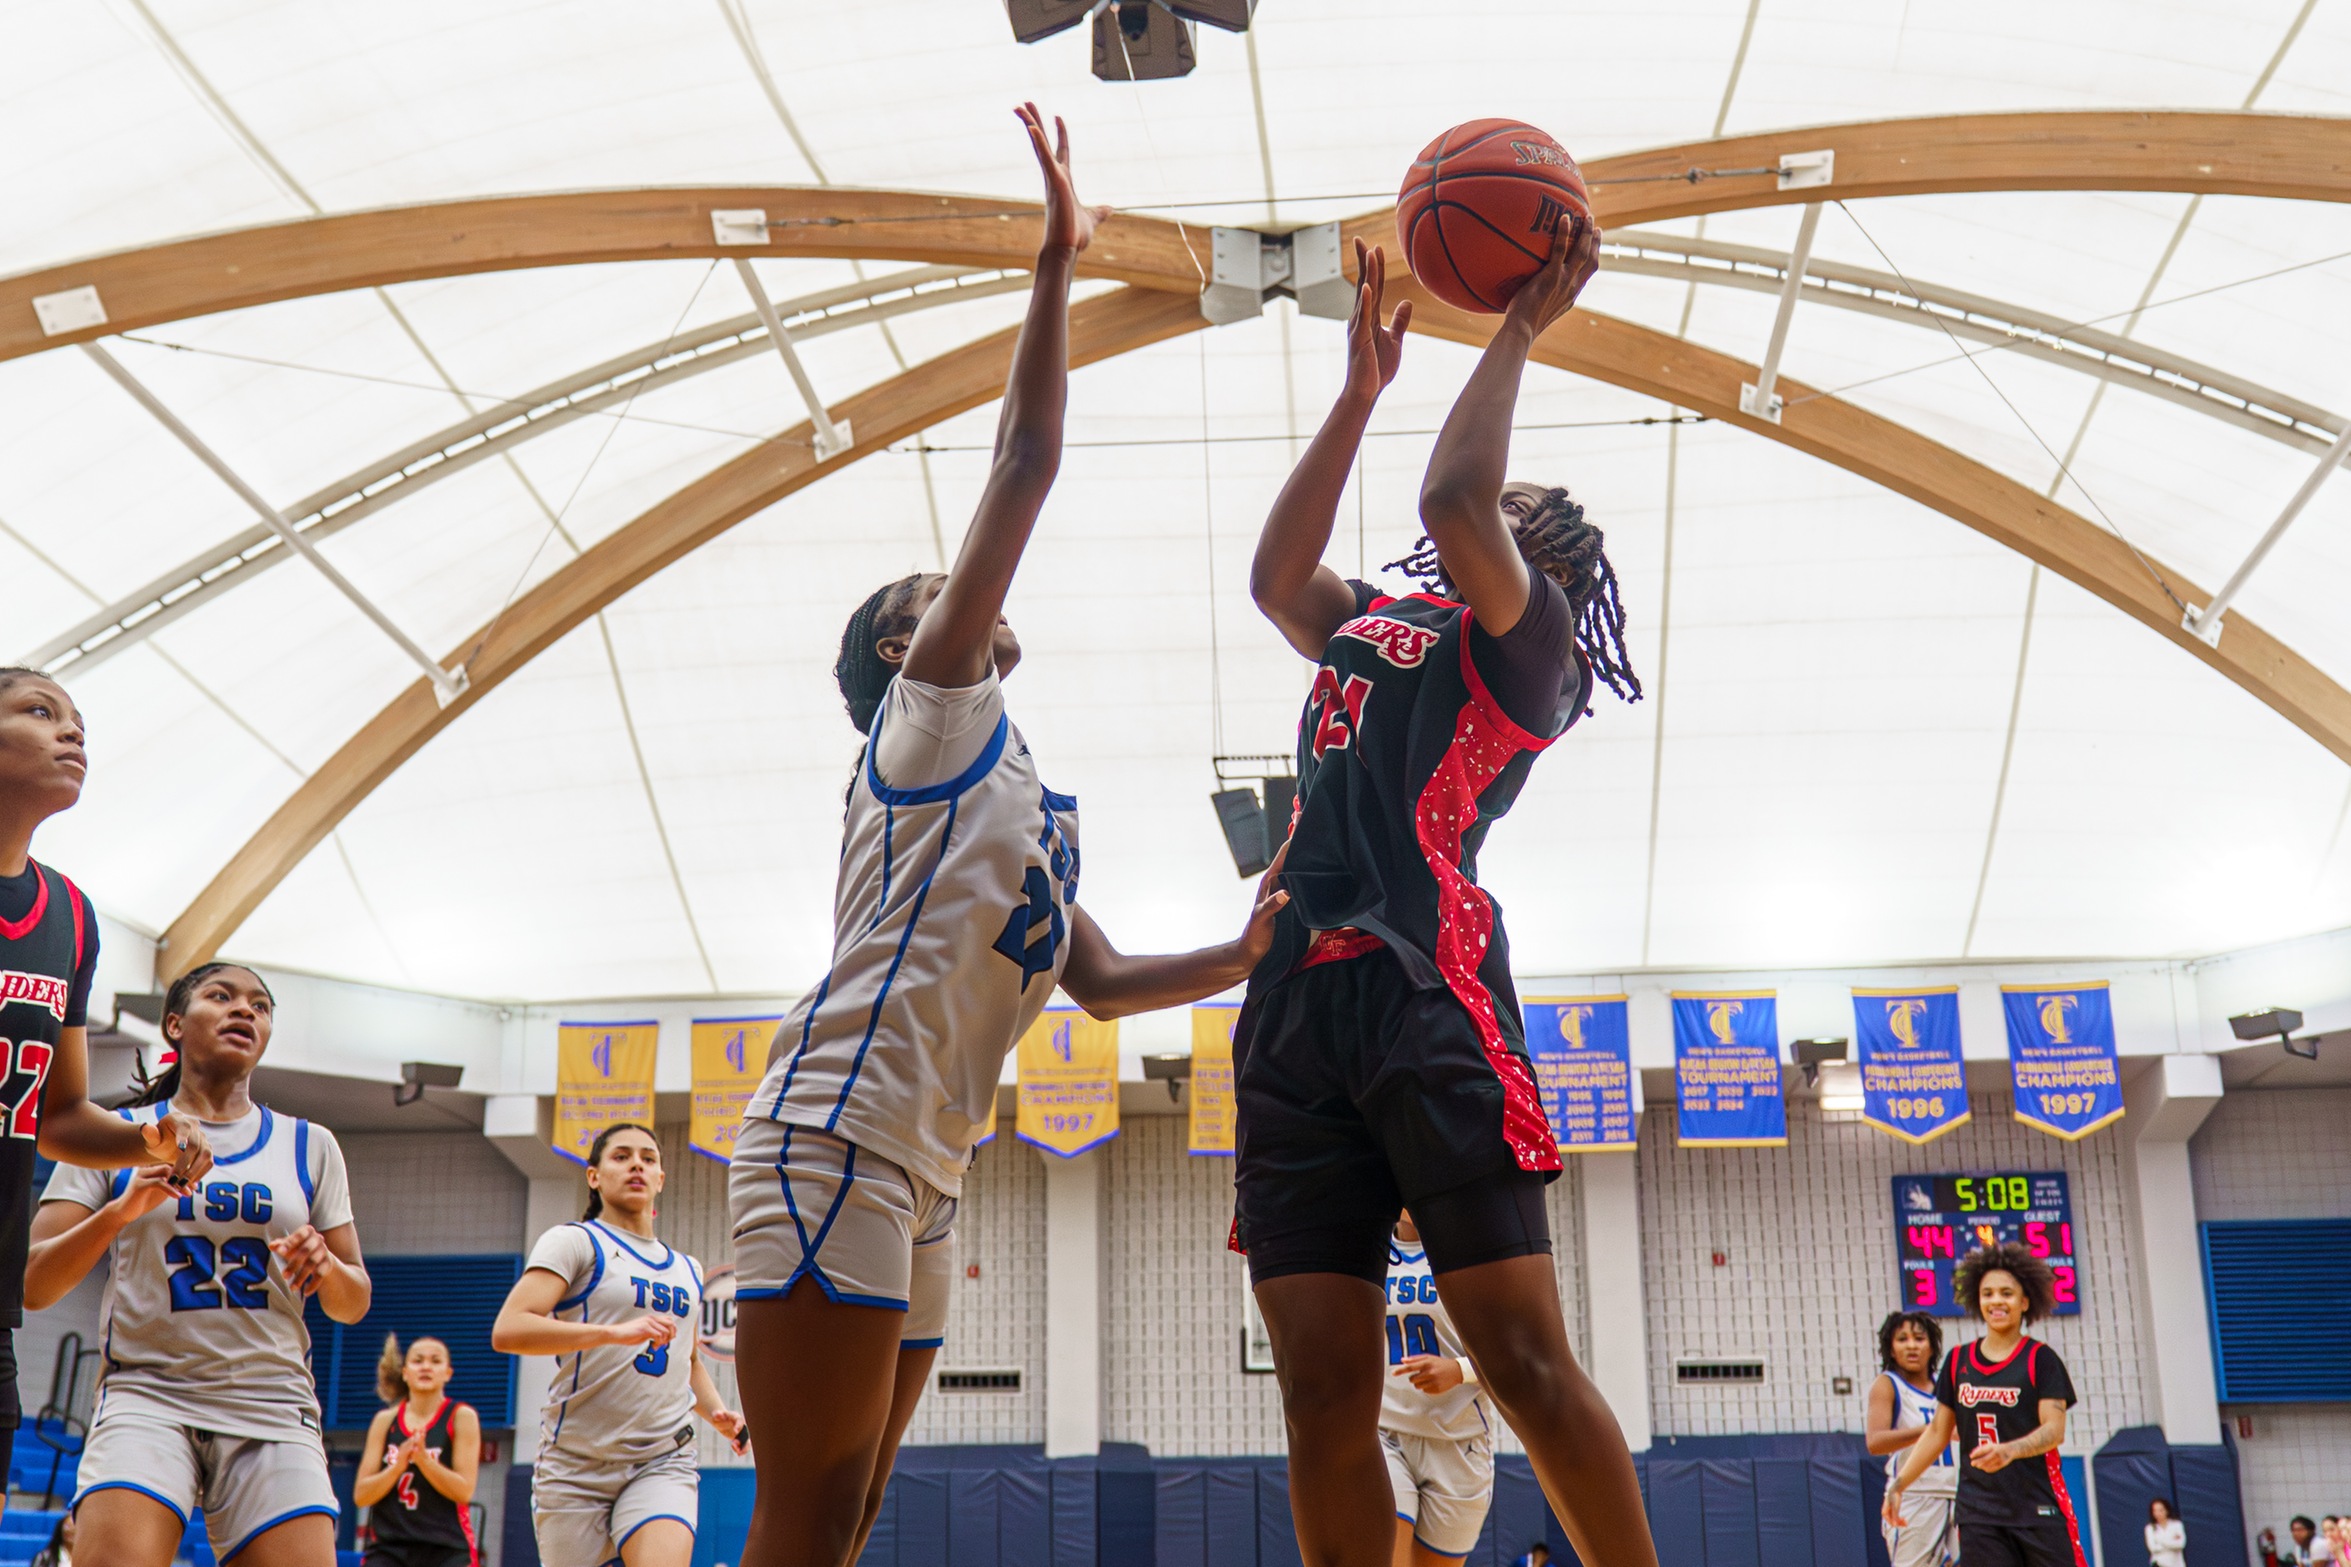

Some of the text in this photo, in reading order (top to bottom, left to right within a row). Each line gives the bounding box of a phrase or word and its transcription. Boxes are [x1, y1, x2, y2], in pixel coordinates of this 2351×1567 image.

[0, 1036, 54, 1140] 2
[1537, 1074, 1627, 1088] OURNAMENT
[1680, 1070, 1778, 1084] TOURNAMENT
[1865, 1076, 1962, 1092] CHAMPIONS
[2016, 1071, 2116, 1088] CHAMPIONS
[1887, 1097, 1945, 1119] 1996
[2039, 1092, 2096, 1115] 1997
[1043, 1113, 1094, 1132] 1997
[1955, 1176, 2030, 1212] 5:08
[1908, 1213, 1943, 1225] HOME
[1968, 1216, 2000, 1226] PERIOD
[2023, 1210, 2060, 1222] GUEST
[1908, 1225, 1954, 1259] 44
[2025, 1222, 2072, 1258] 51
[165, 1235, 270, 1312] 22
[1914, 1269, 1937, 1306] 3
[630, 1275, 690, 1318] TSC
[1385, 1275, 1438, 1305] TSC
[1386, 1314, 1441, 1366] 10
[1958, 1382, 2021, 1409] RAIDERS
[1976, 1413, 2000, 1447] 5
[398, 1472, 419, 1511] 4
